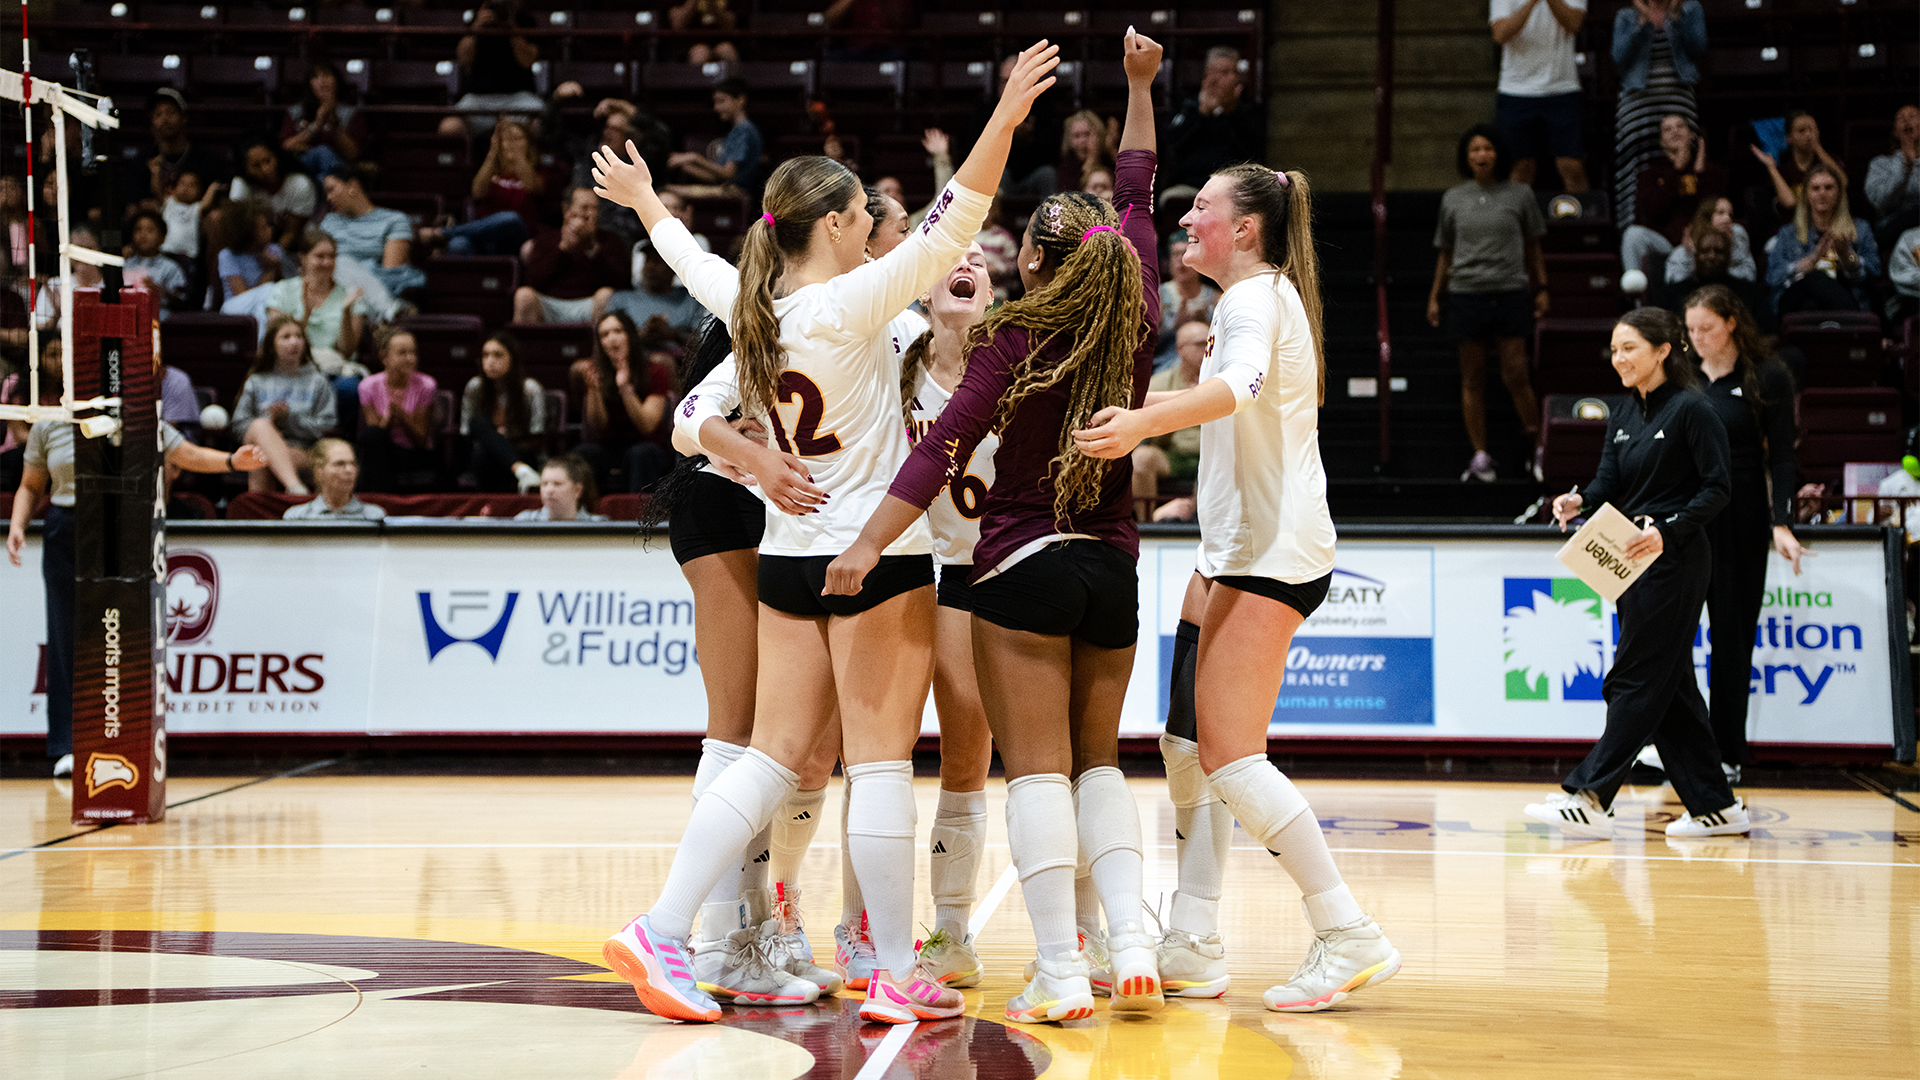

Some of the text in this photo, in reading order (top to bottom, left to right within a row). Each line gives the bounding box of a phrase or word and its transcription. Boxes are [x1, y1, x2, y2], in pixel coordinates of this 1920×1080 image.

[1585, 539, 1632, 580] molten
[1327, 587, 1386, 604] EATY
[1762, 587, 1833, 607] olina
[537, 591, 693, 626] William
[102, 607, 121, 666] sports
[1286, 645, 1387, 671] Owners
[1281, 672, 1350, 687] RANCE
[166, 701, 320, 714] REDIT UNION
[1275, 696, 1386, 709] uman sense
